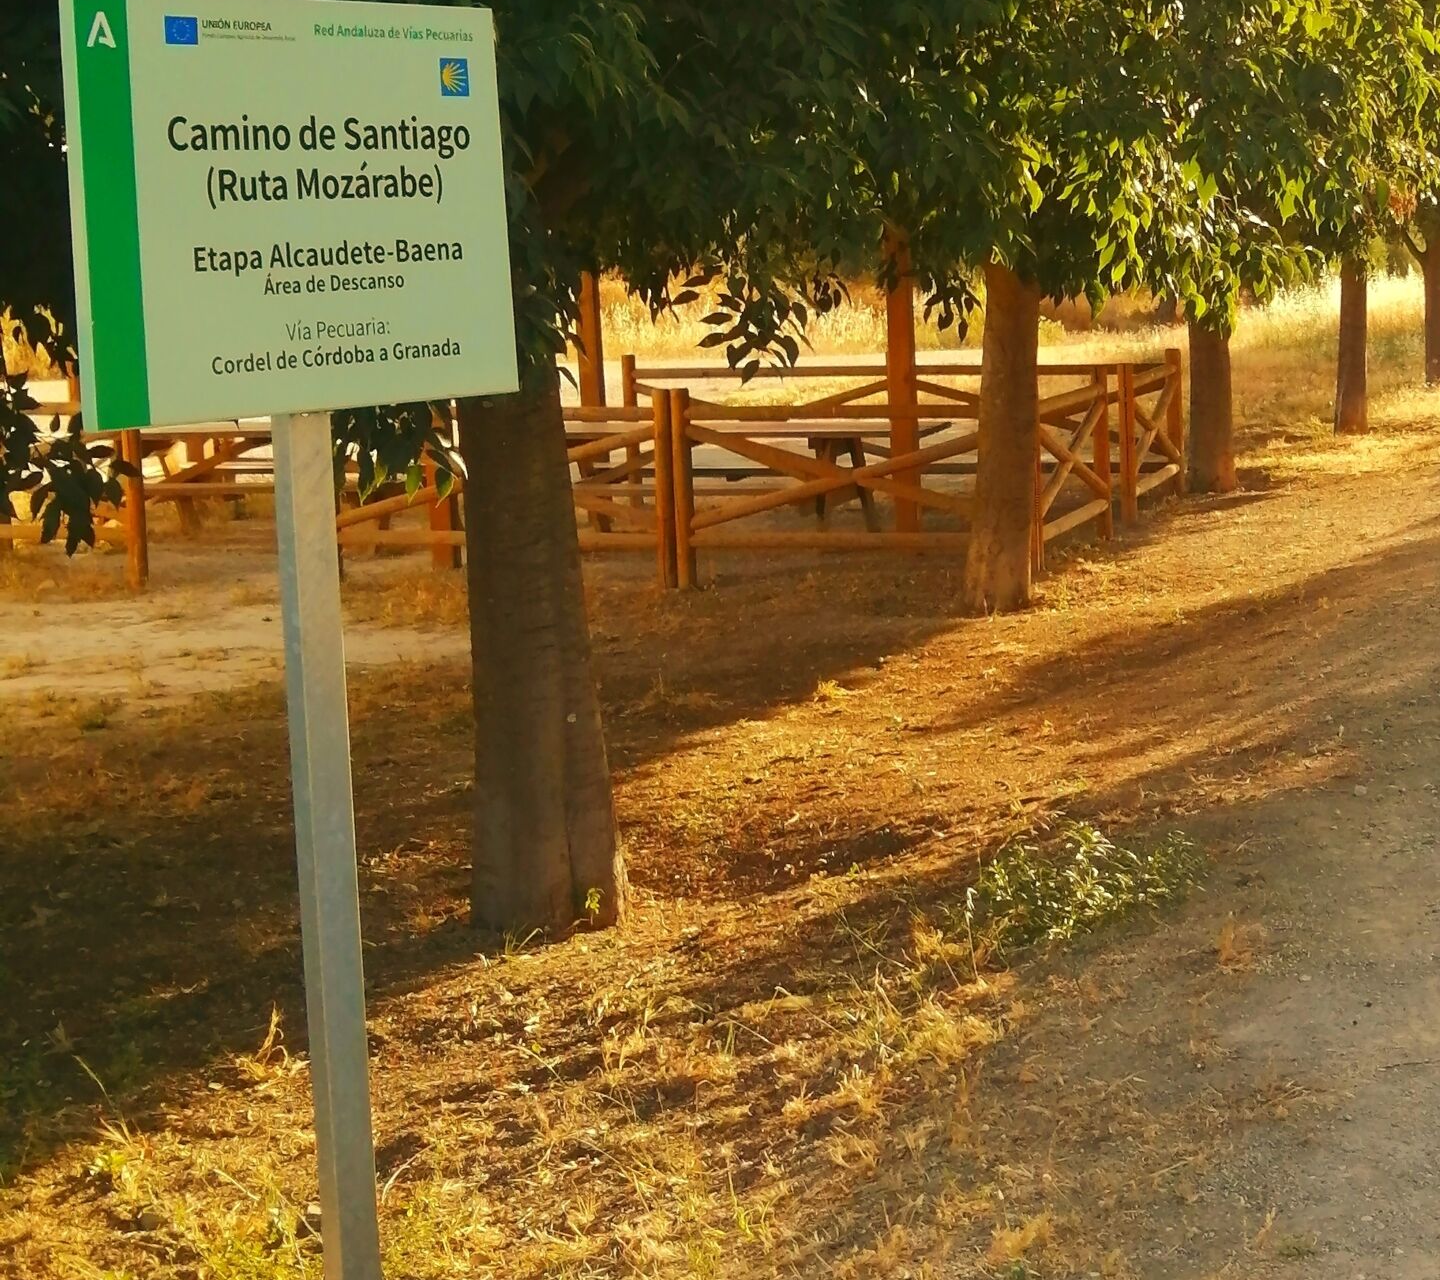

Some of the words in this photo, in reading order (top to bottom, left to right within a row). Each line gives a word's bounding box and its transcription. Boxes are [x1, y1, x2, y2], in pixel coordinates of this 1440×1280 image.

[233, 20, 272, 32] EUROPEA
[313, 23, 334, 37] Red
[336, 24, 386, 38] Andaluza
[387, 26, 401, 39] de
[402, 27, 424, 40] Vías
[425, 28, 474, 42] Pecuarias
[167, 115, 291, 152] Camino
[299, 114, 336, 151] de
[343, 115, 471, 158] Santiago
[206, 165, 289, 209] (Ruta
[296, 161, 443, 205] Mozárabe)
[193, 245, 263, 276] Etapa
[269, 239, 464, 269] Alcaudete-Baena
[263, 273, 302, 295] Área
[305, 276, 327, 294] de
[329, 274, 405, 293] Descanso
[285, 320, 312, 341] Vía
[316, 317, 391, 343] Pecuaria:
[211, 350, 272, 375] Cordel
[275, 351, 298, 372] de
[302, 344, 375, 369] Córdoba
[379, 348, 388, 362] a
[392, 339, 461, 360] Granada
